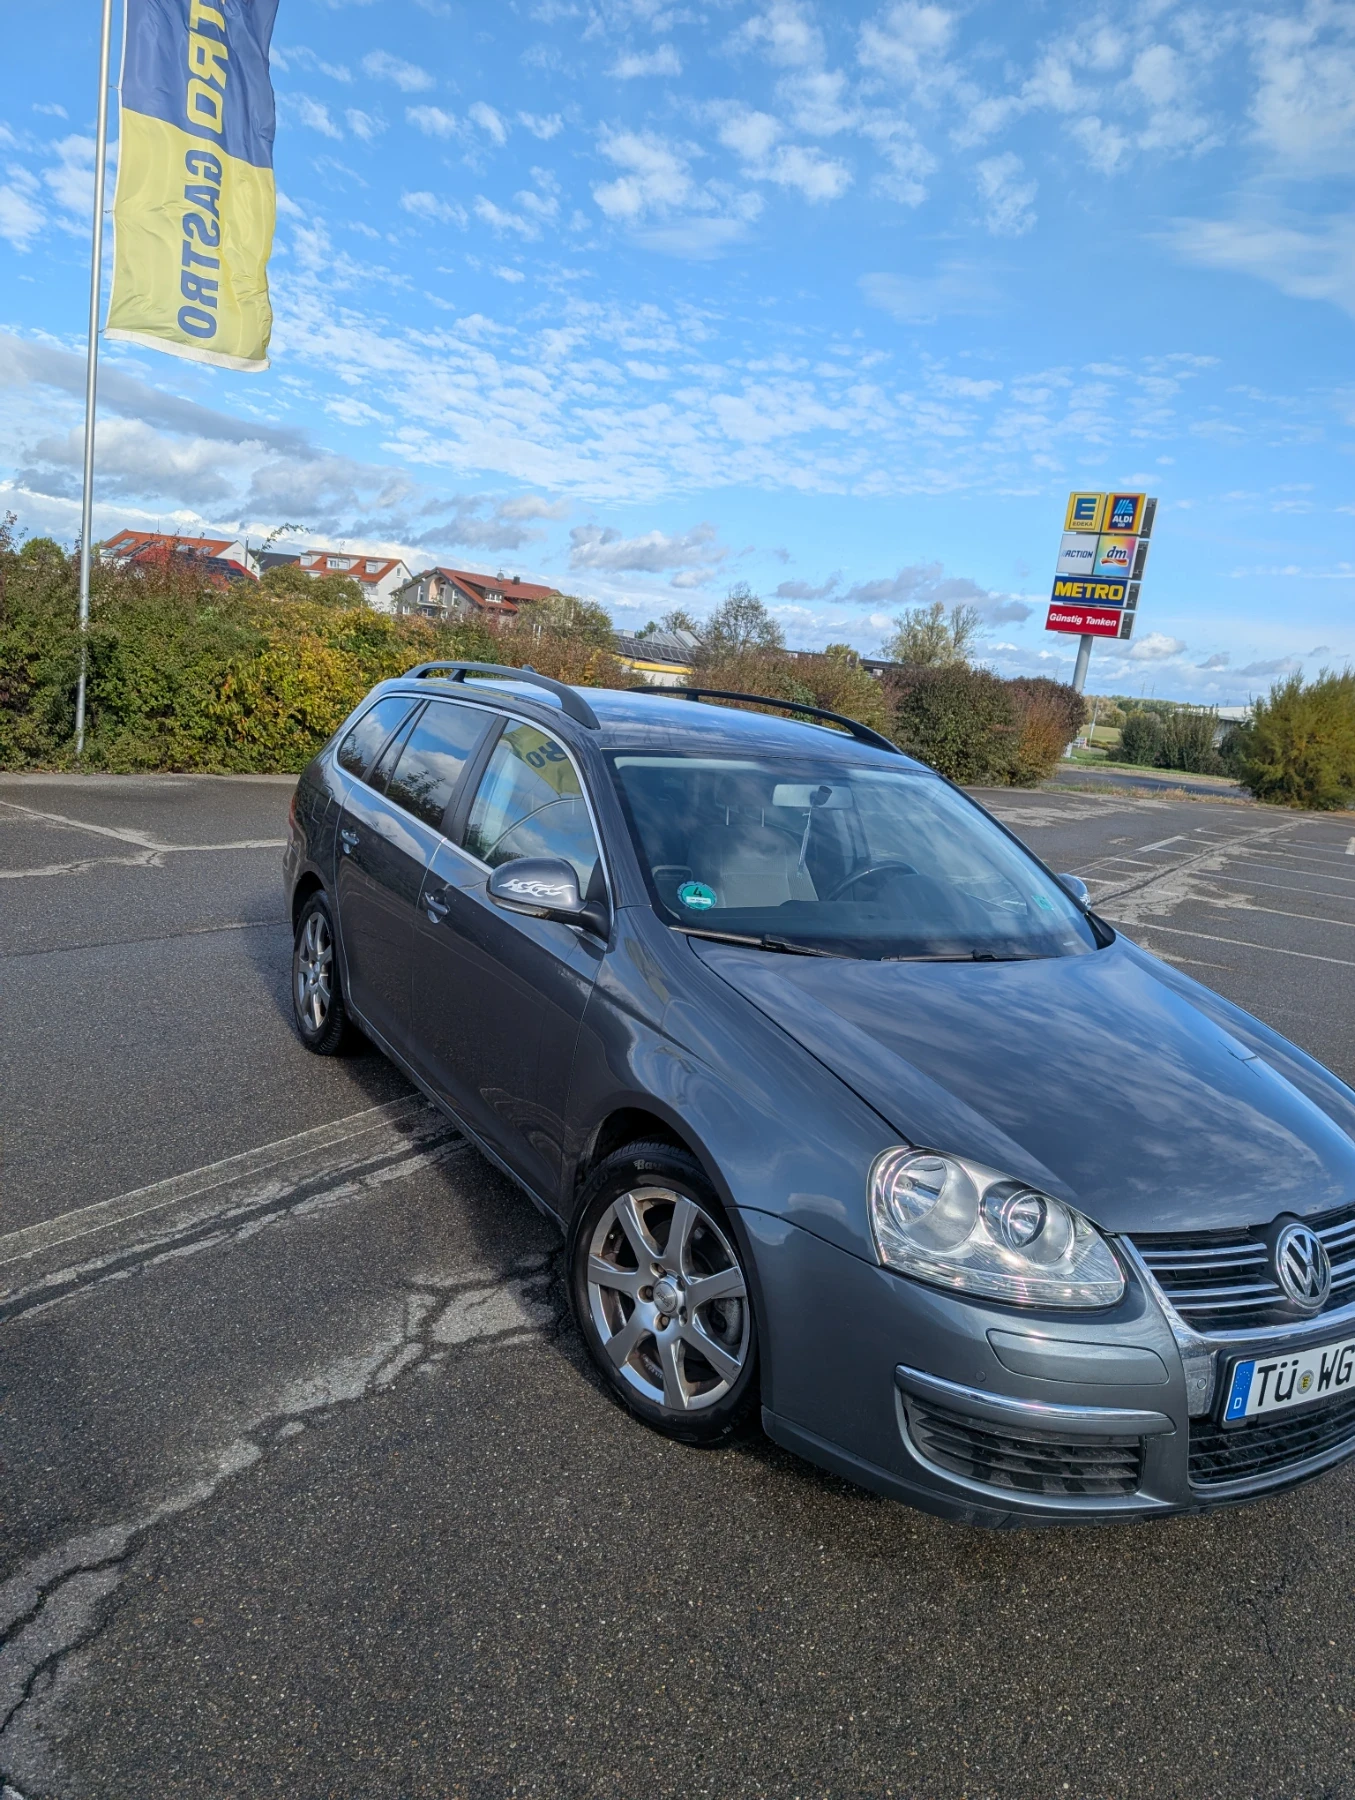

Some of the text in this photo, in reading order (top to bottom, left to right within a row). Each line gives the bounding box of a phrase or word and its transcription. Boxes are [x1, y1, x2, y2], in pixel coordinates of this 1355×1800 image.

[1112, 515, 1133, 523] ALDI
[1065, 549, 1094, 558] ACTION
[1107, 546, 1127, 559] dm
[1054, 581, 1124, 600] METRO
[1049, 613, 1117, 627] Günstig Tanken
[692, 887, 703, 897] 4
[1257, 1344, 1355, 1407] TÜ WG
[1233, 1397, 1243, 1410] D
